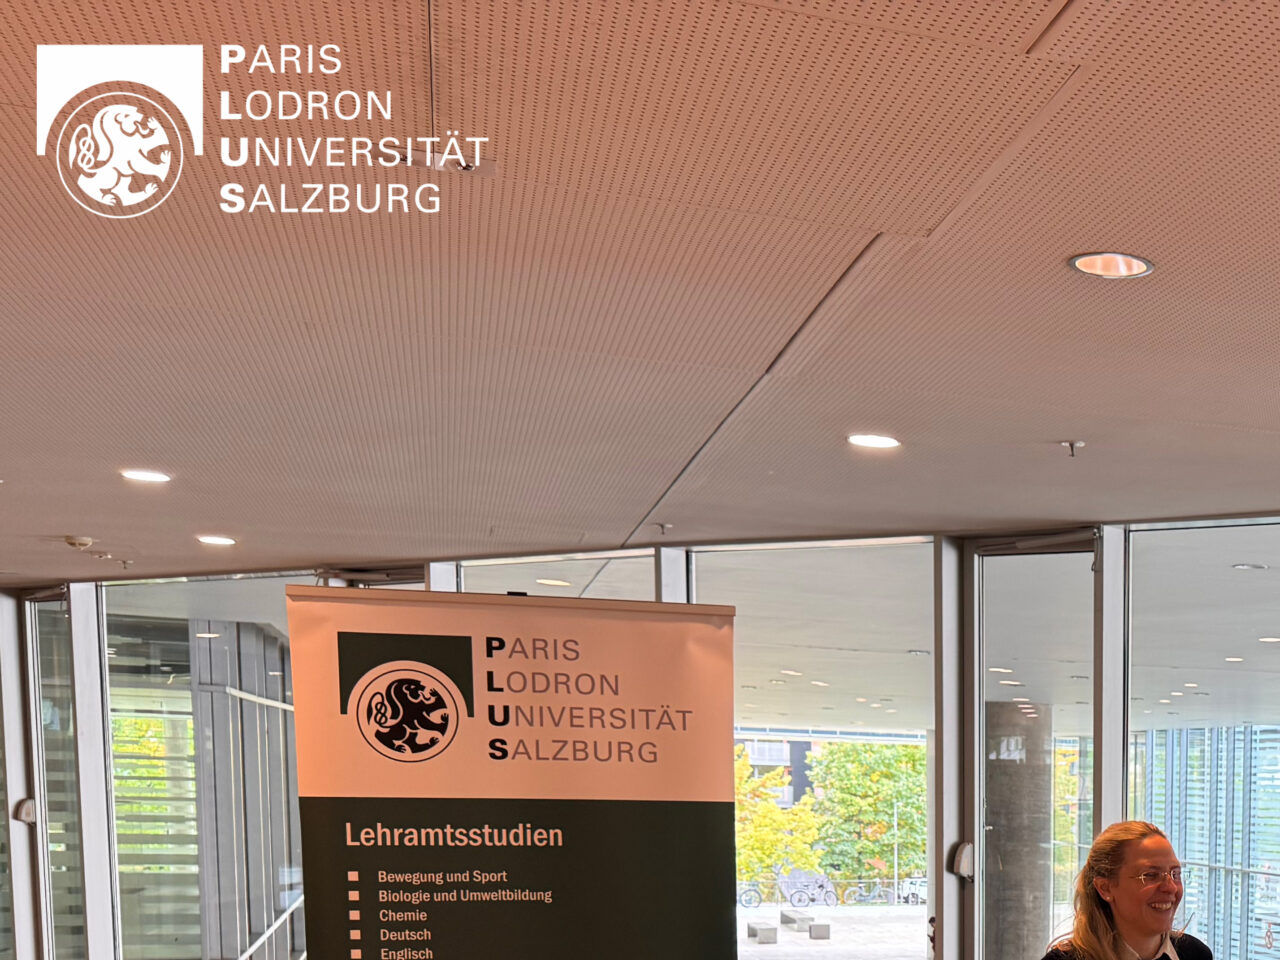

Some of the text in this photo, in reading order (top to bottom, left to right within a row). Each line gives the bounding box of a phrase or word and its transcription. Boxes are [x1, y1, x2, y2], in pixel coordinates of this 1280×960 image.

[485, 636, 580, 661] PARIS
[486, 670, 620, 696] LODRON
[488, 704, 694, 732] UNIVERSITÄT
[488, 738, 659, 764] SALZBURG
[345, 821, 564, 848] Lehramtsstudien
[378, 870, 507, 885] Bewegung und Sport
[378, 889, 552, 904] Biologie und Umweltbildung
[379, 909, 427, 921] Chemie
[380, 929, 431, 941] Deutsch
